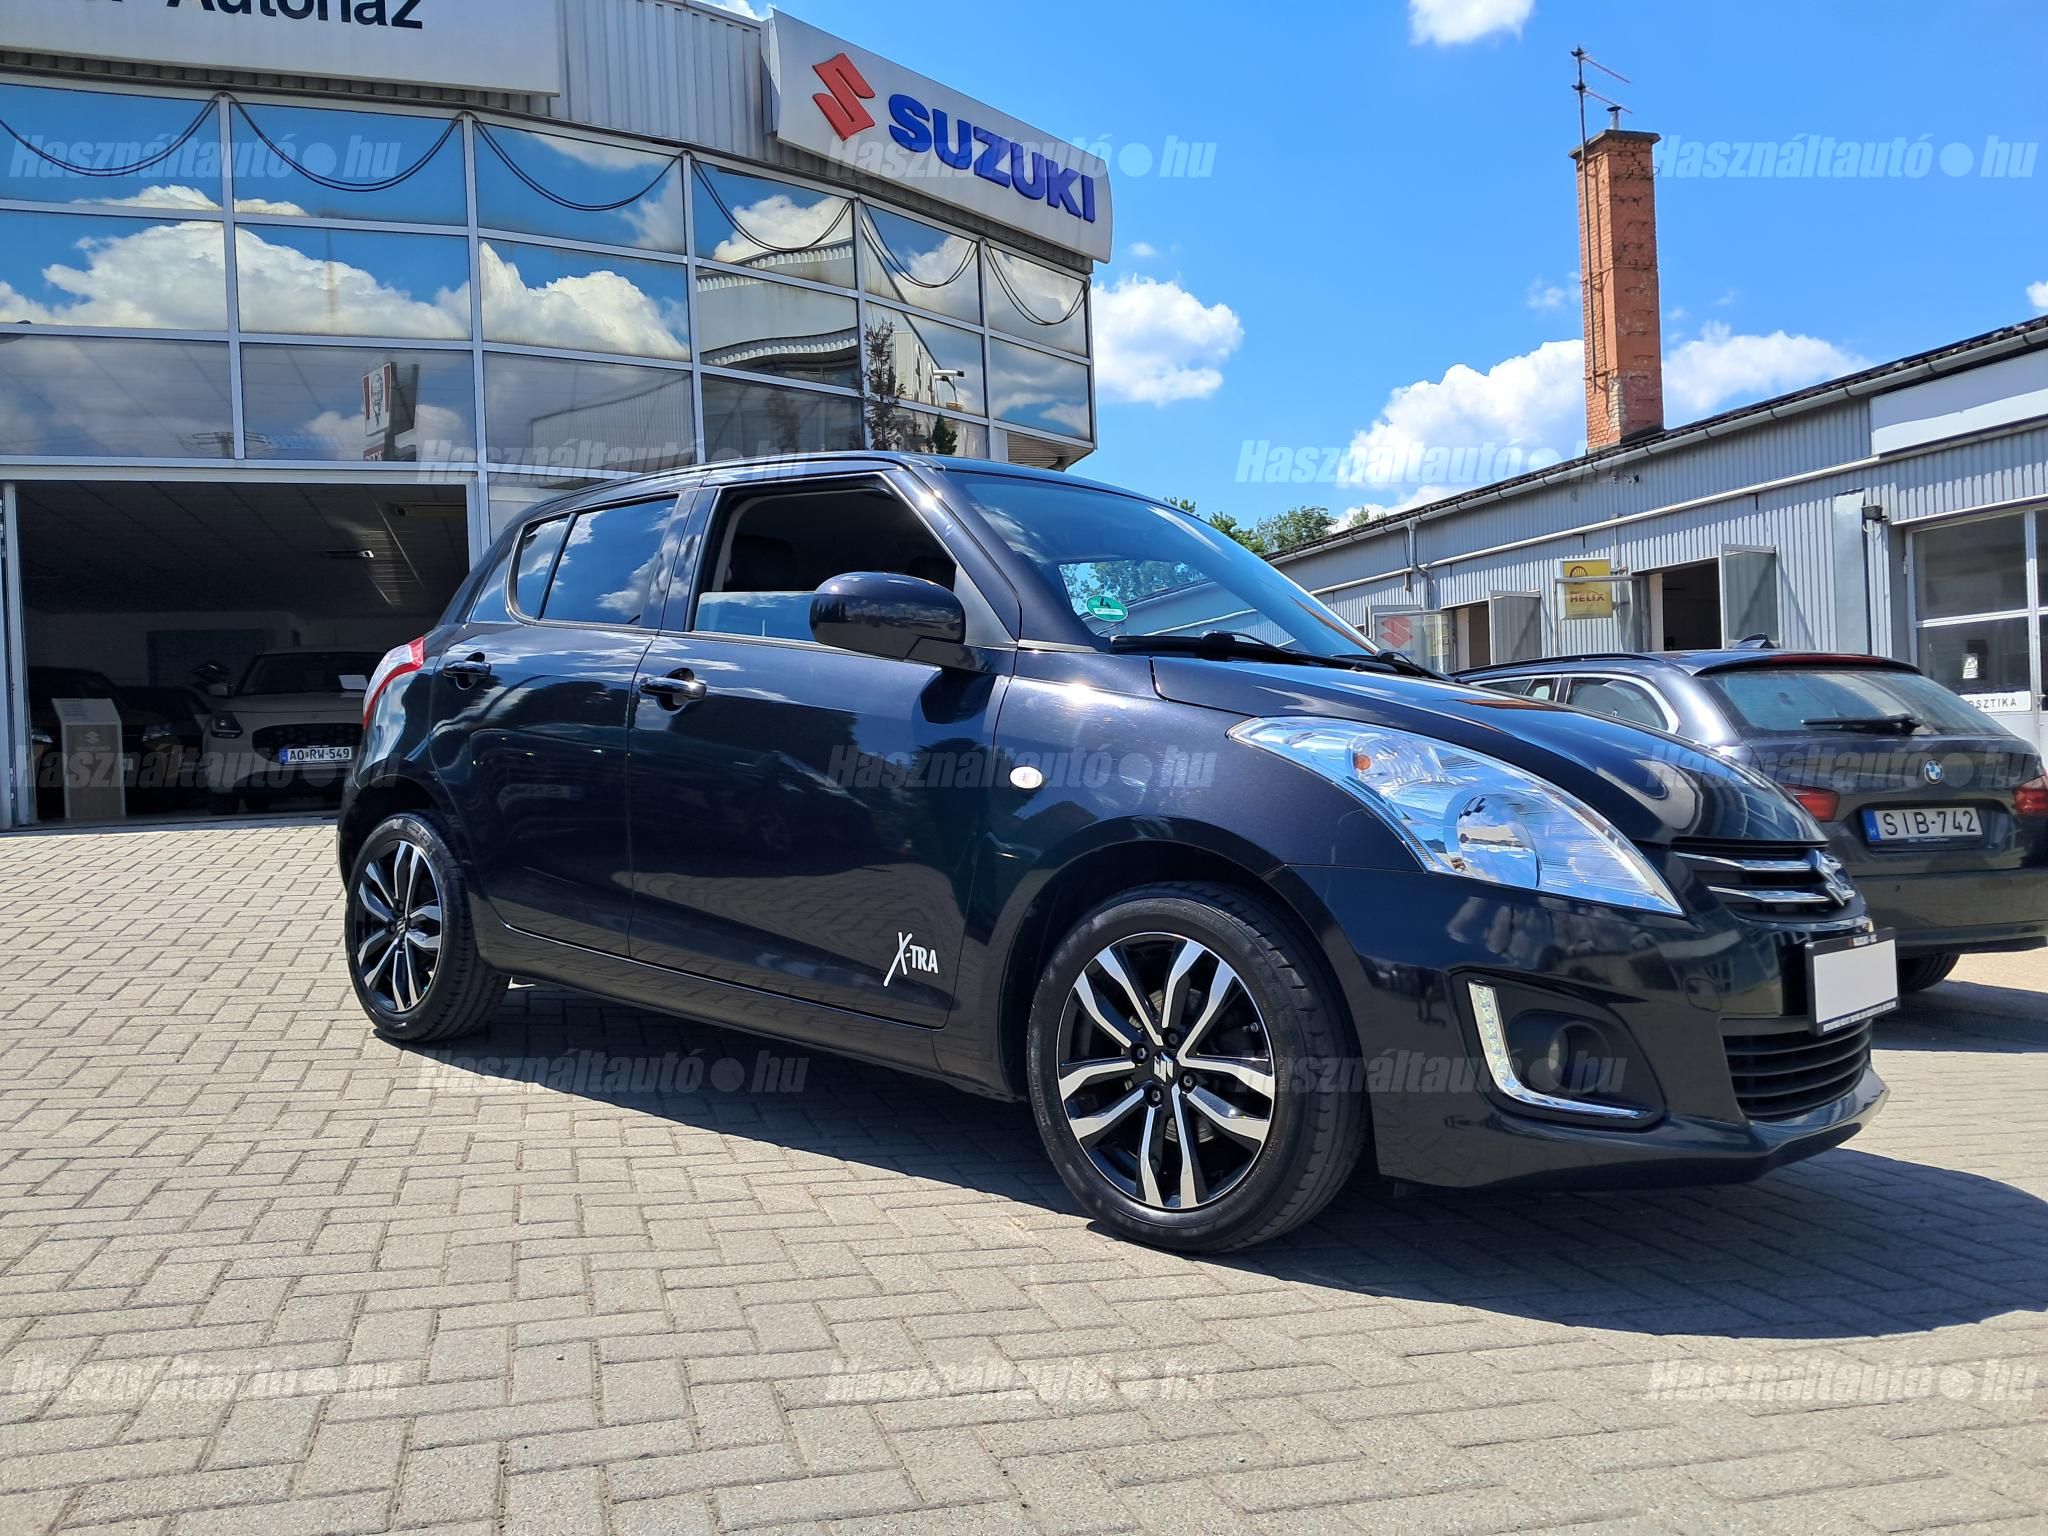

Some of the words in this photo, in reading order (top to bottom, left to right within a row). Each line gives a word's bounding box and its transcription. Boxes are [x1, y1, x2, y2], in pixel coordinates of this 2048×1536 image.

[888, 94, 1096, 224] SUZUKI
[1570, 593, 1605, 603] HELIX
[1883, 810, 1977, 836] SIB-742
[883, 931, 939, 987] X-TRA
